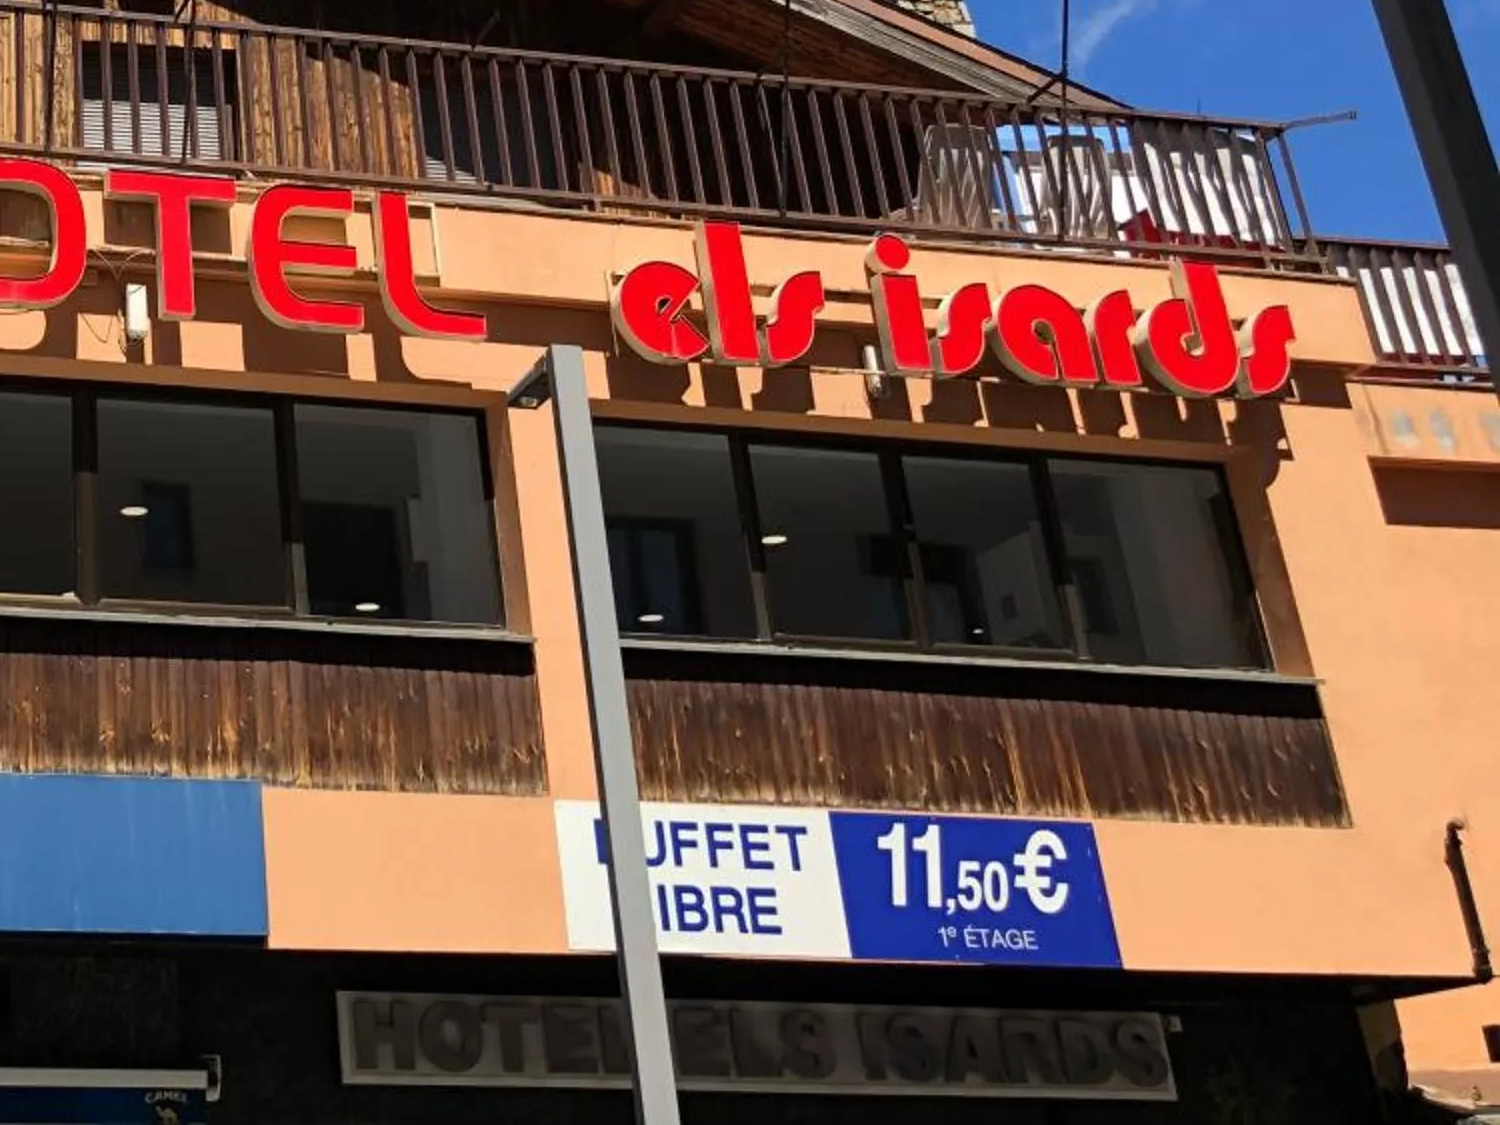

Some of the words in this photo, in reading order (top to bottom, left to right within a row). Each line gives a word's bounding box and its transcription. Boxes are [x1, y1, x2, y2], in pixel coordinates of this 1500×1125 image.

[612, 220, 825, 366] els
[865, 233, 1297, 399] isards
[594, 818, 807, 872] UFFET
[657, 884, 783, 935] IBRE
[963, 924, 1039, 950] ÉTAGE
[856, 1011, 1168, 1089] ISARDS
